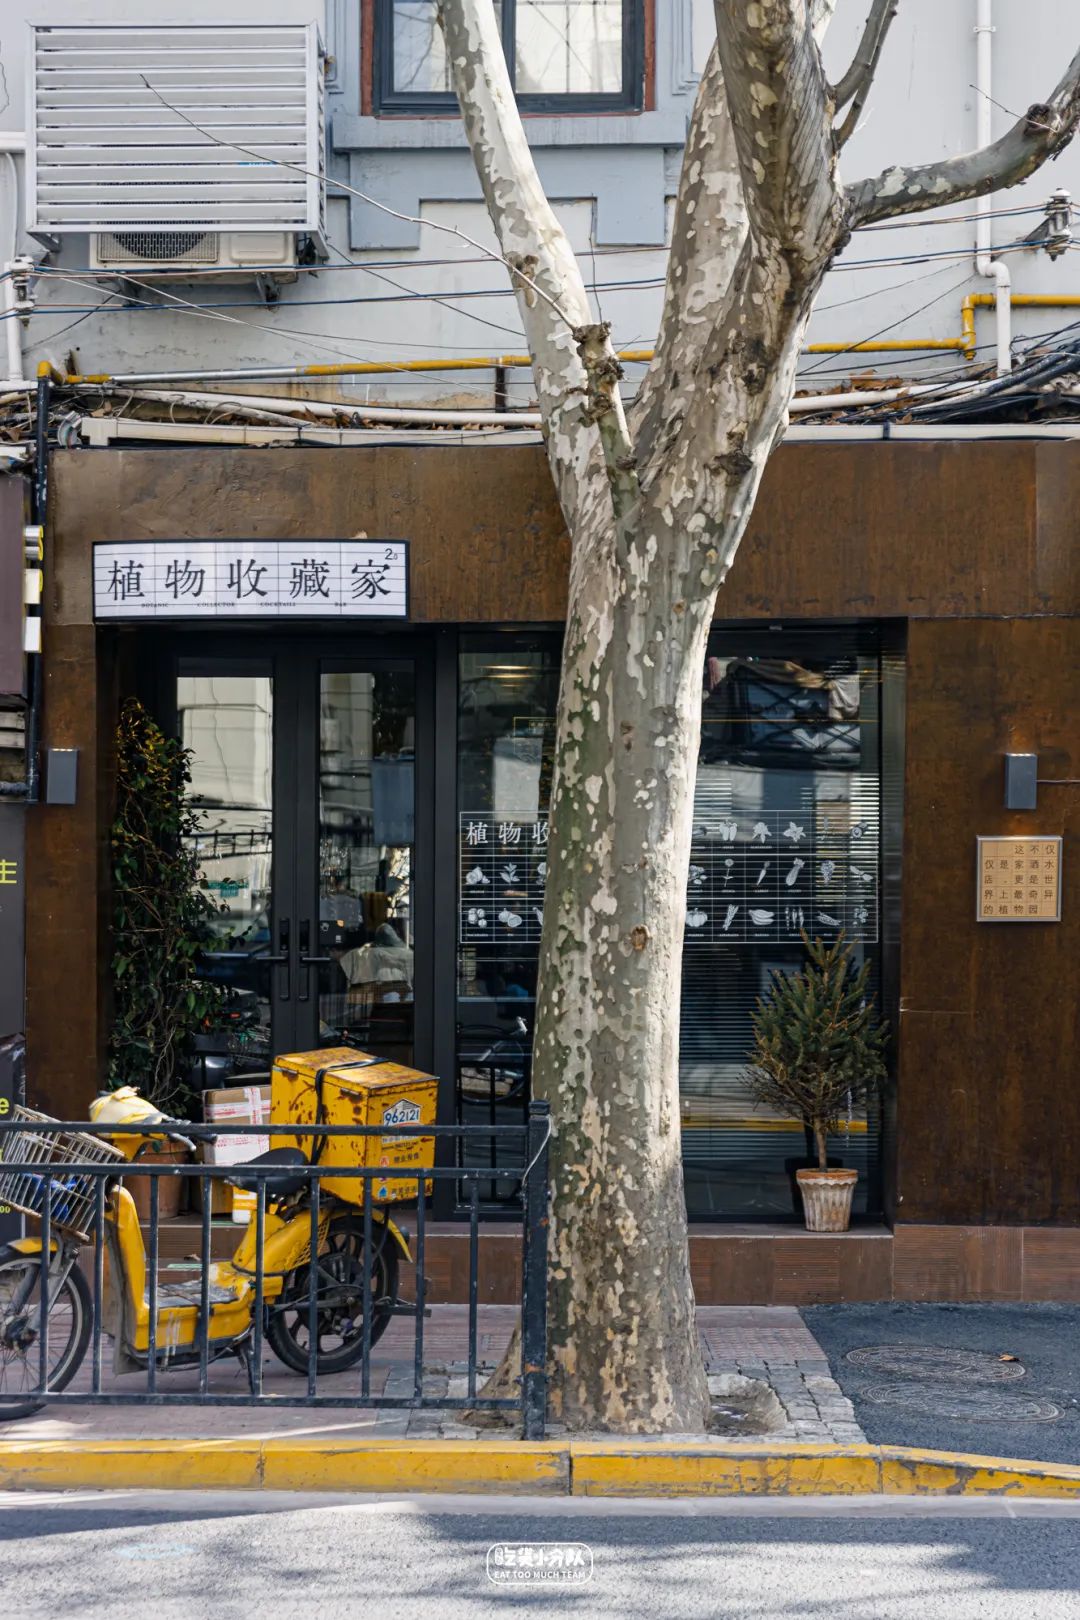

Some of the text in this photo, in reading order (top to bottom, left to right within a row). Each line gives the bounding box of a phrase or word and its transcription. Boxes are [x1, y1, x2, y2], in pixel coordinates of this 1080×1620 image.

[108, 559, 391, 600] 植物收藏家
[466, 821, 549, 845] 植物收
[1015, 845, 1055, 855] 这不仅
[984, 890, 1053, 900] 界上最奇异
[983, 904, 1038, 915] 的植物园
[385, 1108, 419, 1127] 962121
